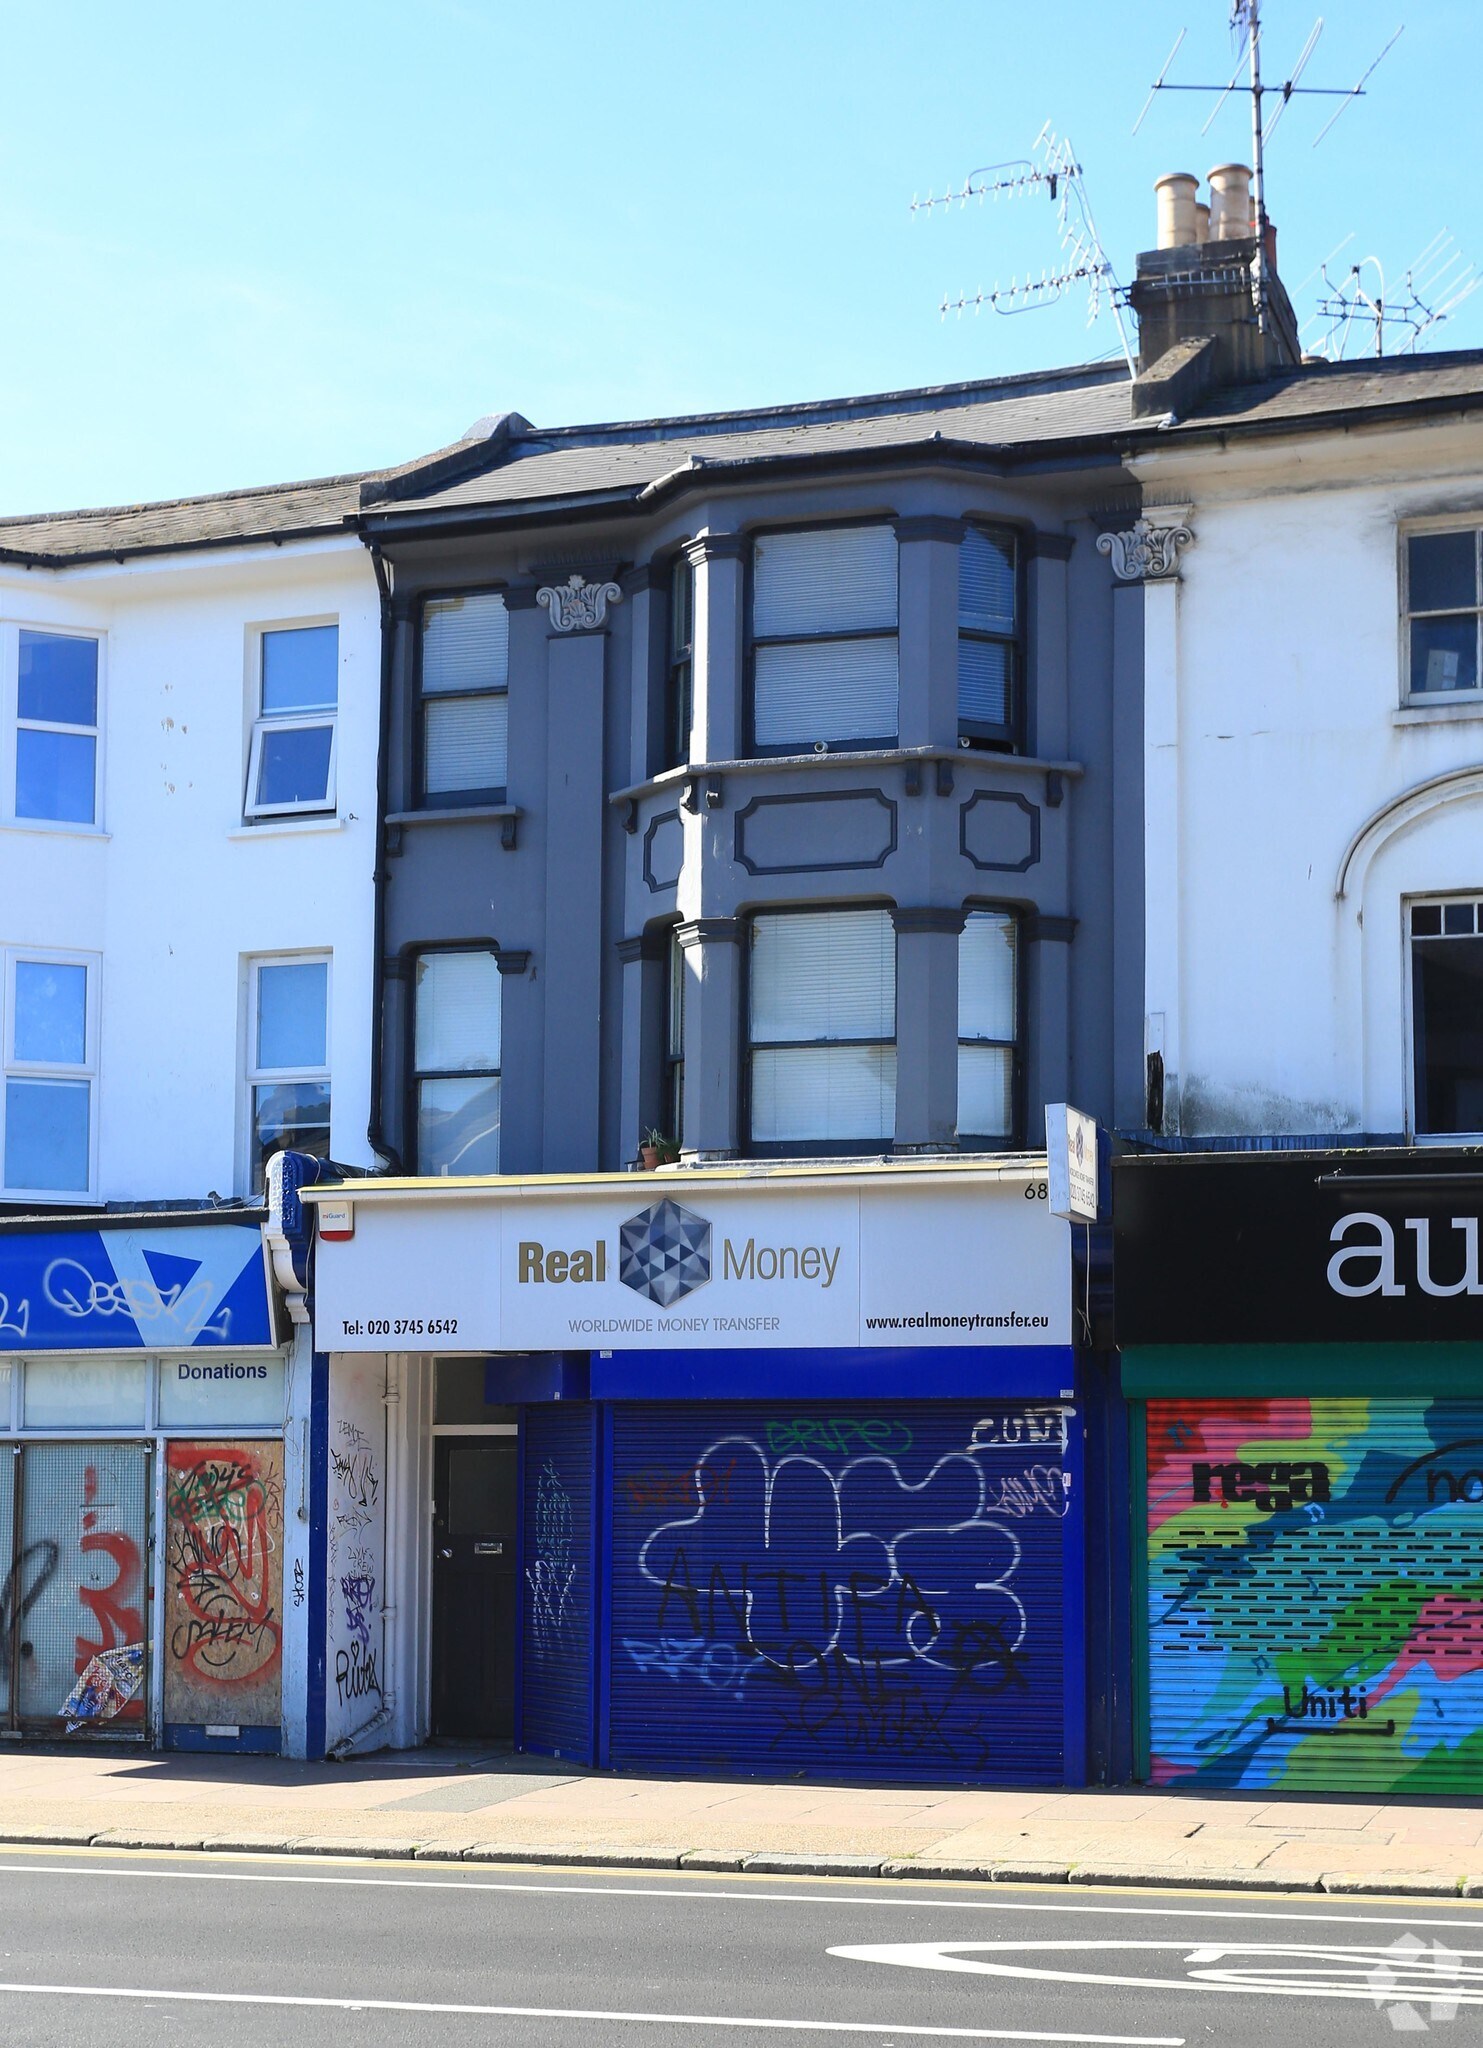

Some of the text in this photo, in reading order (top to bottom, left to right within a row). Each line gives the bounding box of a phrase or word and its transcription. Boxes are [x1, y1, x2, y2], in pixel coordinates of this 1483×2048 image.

[1024, 1182, 1048, 1200] 68
[518, 1237, 841, 1289] Real Money
[1326, 1212, 1483, 1298] au
[342, 1319, 458, 1335] Tel: 020 3745 6542
[568, 1316, 780, 1333] WORLDWIDE MONEY TRANSFER
[865, 1310, 1049, 1332] www.realmoneytransfer.eu
[177, 1362, 267, 1381] Donations
[657, 1546, 942, 1638] ANTIFA
